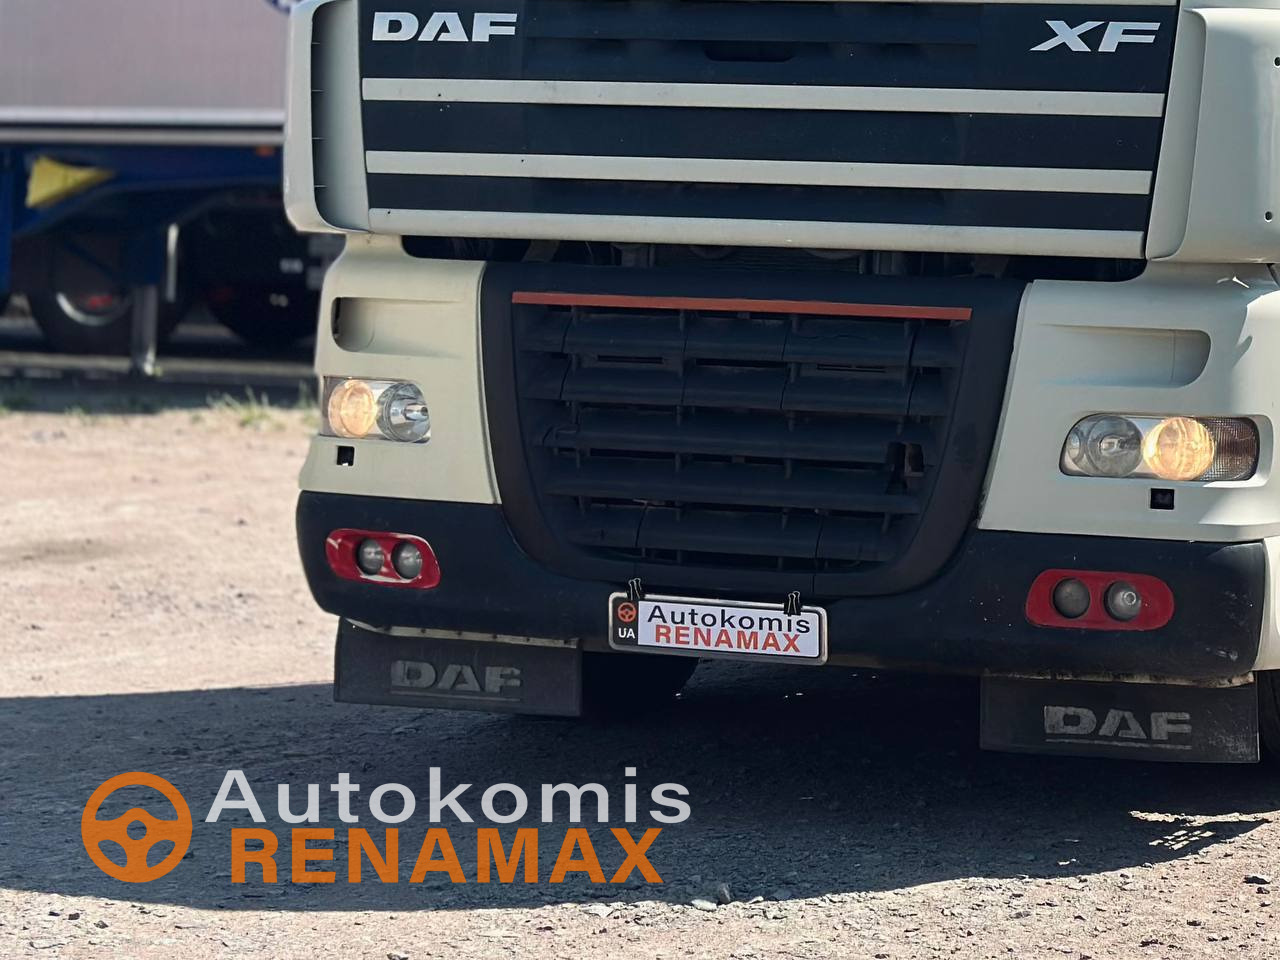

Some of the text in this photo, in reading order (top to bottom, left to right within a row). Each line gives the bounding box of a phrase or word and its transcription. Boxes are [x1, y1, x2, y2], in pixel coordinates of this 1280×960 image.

[372, 12, 517, 42] DAF
[1029, 20, 1161, 52] XF
[618, 627, 635, 639] UA
[647, 605, 811, 634] Autokomis
[655, 624, 801, 652] RENAMAX
[391, 660, 521, 693] DAF
[1044, 705, 1192, 740] DAF
